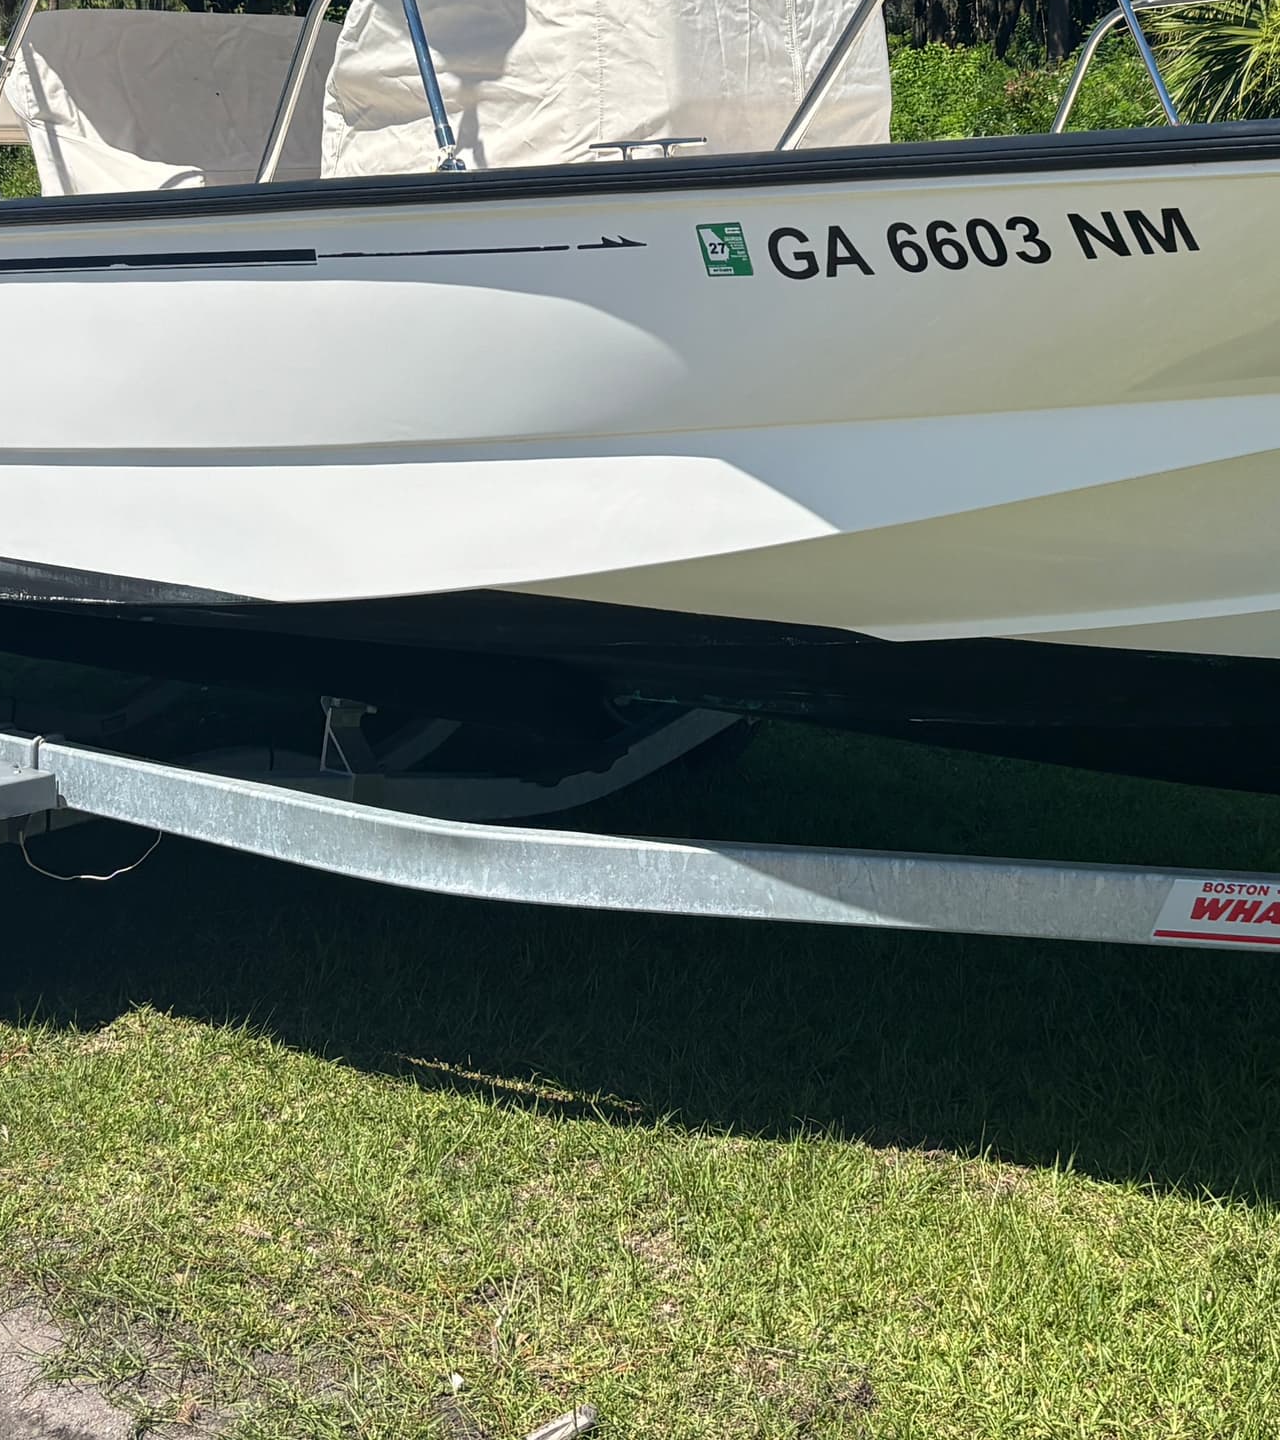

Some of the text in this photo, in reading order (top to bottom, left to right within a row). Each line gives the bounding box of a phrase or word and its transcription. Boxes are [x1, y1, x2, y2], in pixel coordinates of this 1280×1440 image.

[708, 242, 726, 255] 27
[767, 224, 876, 280] GA
[886, 216, 1052, 273] 6603
[1066, 207, 1201, 260] NM
[1202, 882, 1270, 896] BOSTON
